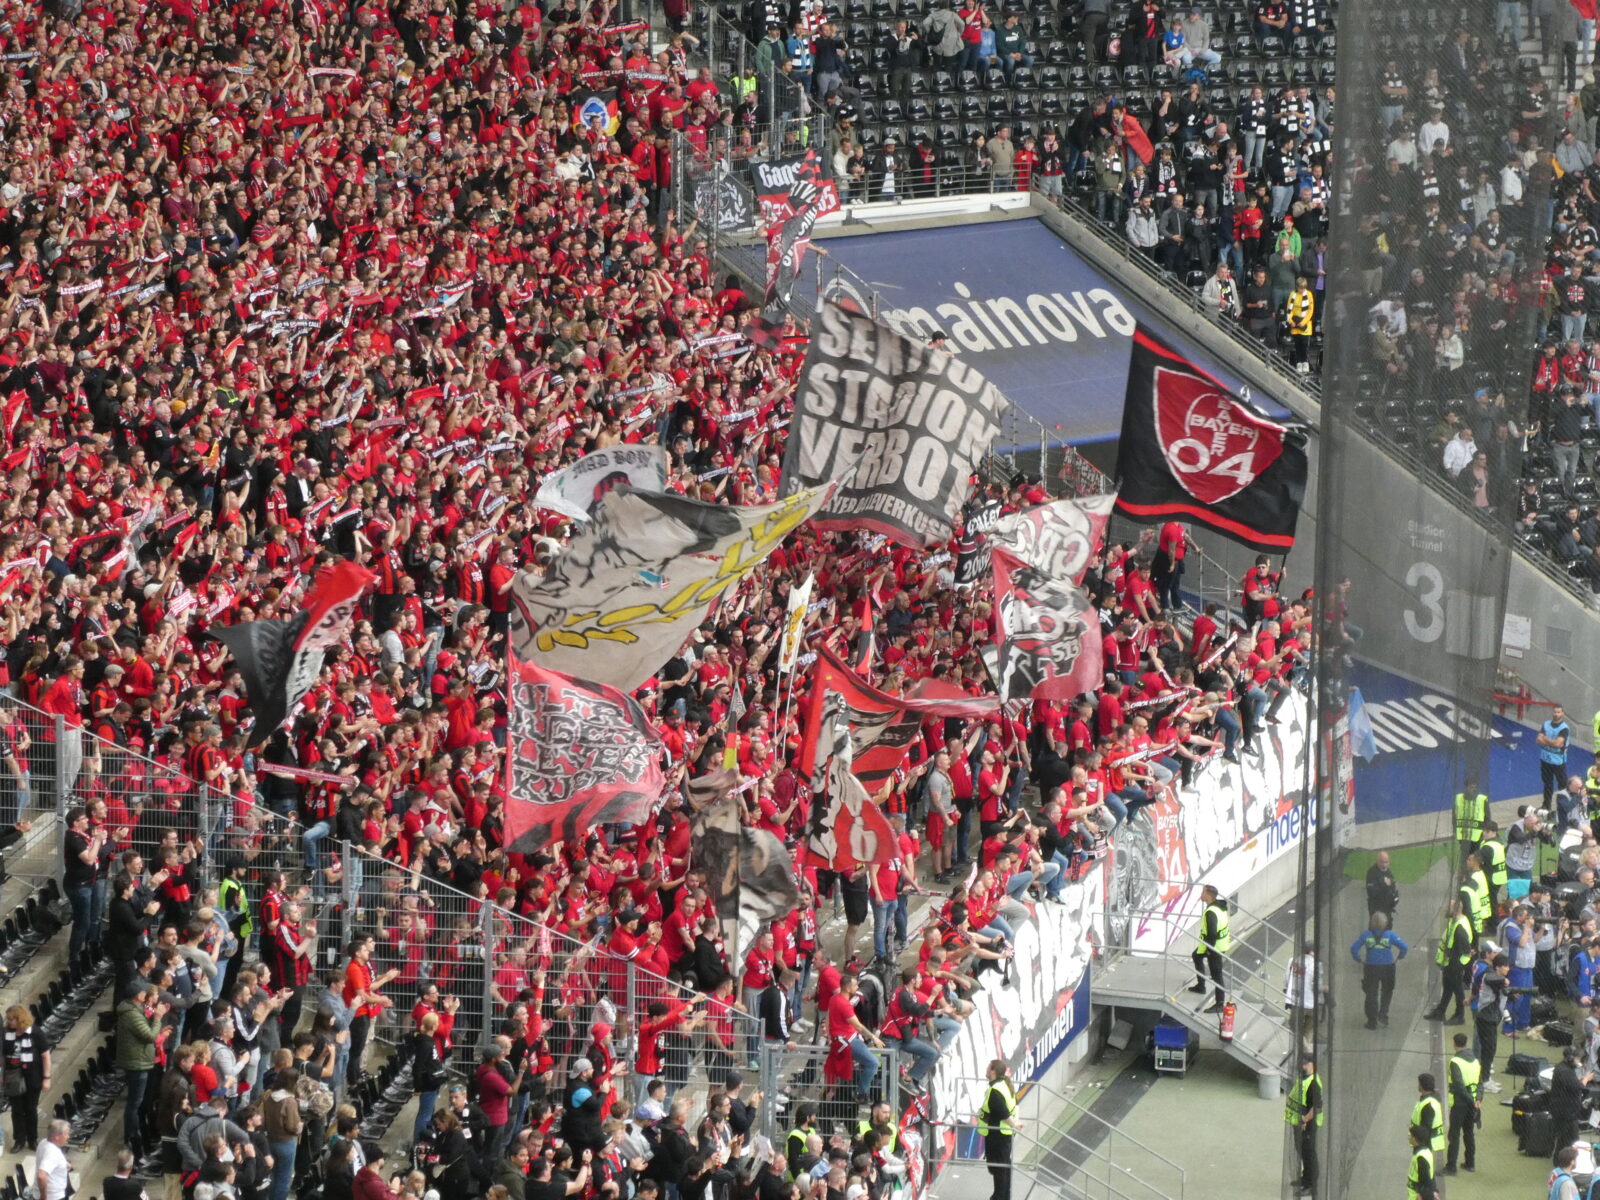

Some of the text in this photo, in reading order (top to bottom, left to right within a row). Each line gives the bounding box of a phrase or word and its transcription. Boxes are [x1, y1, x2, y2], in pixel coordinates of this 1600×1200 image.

[880, 281, 1137, 354] mainova
[803, 362, 1002, 472] STADION
[1190, 413, 1258, 439] BAYER
[799, 414, 976, 521] VERBOT
[1168, 438, 1256, 485] 04
[1403, 561, 1444, 643] 3
[1266, 797, 1317, 857] inded
